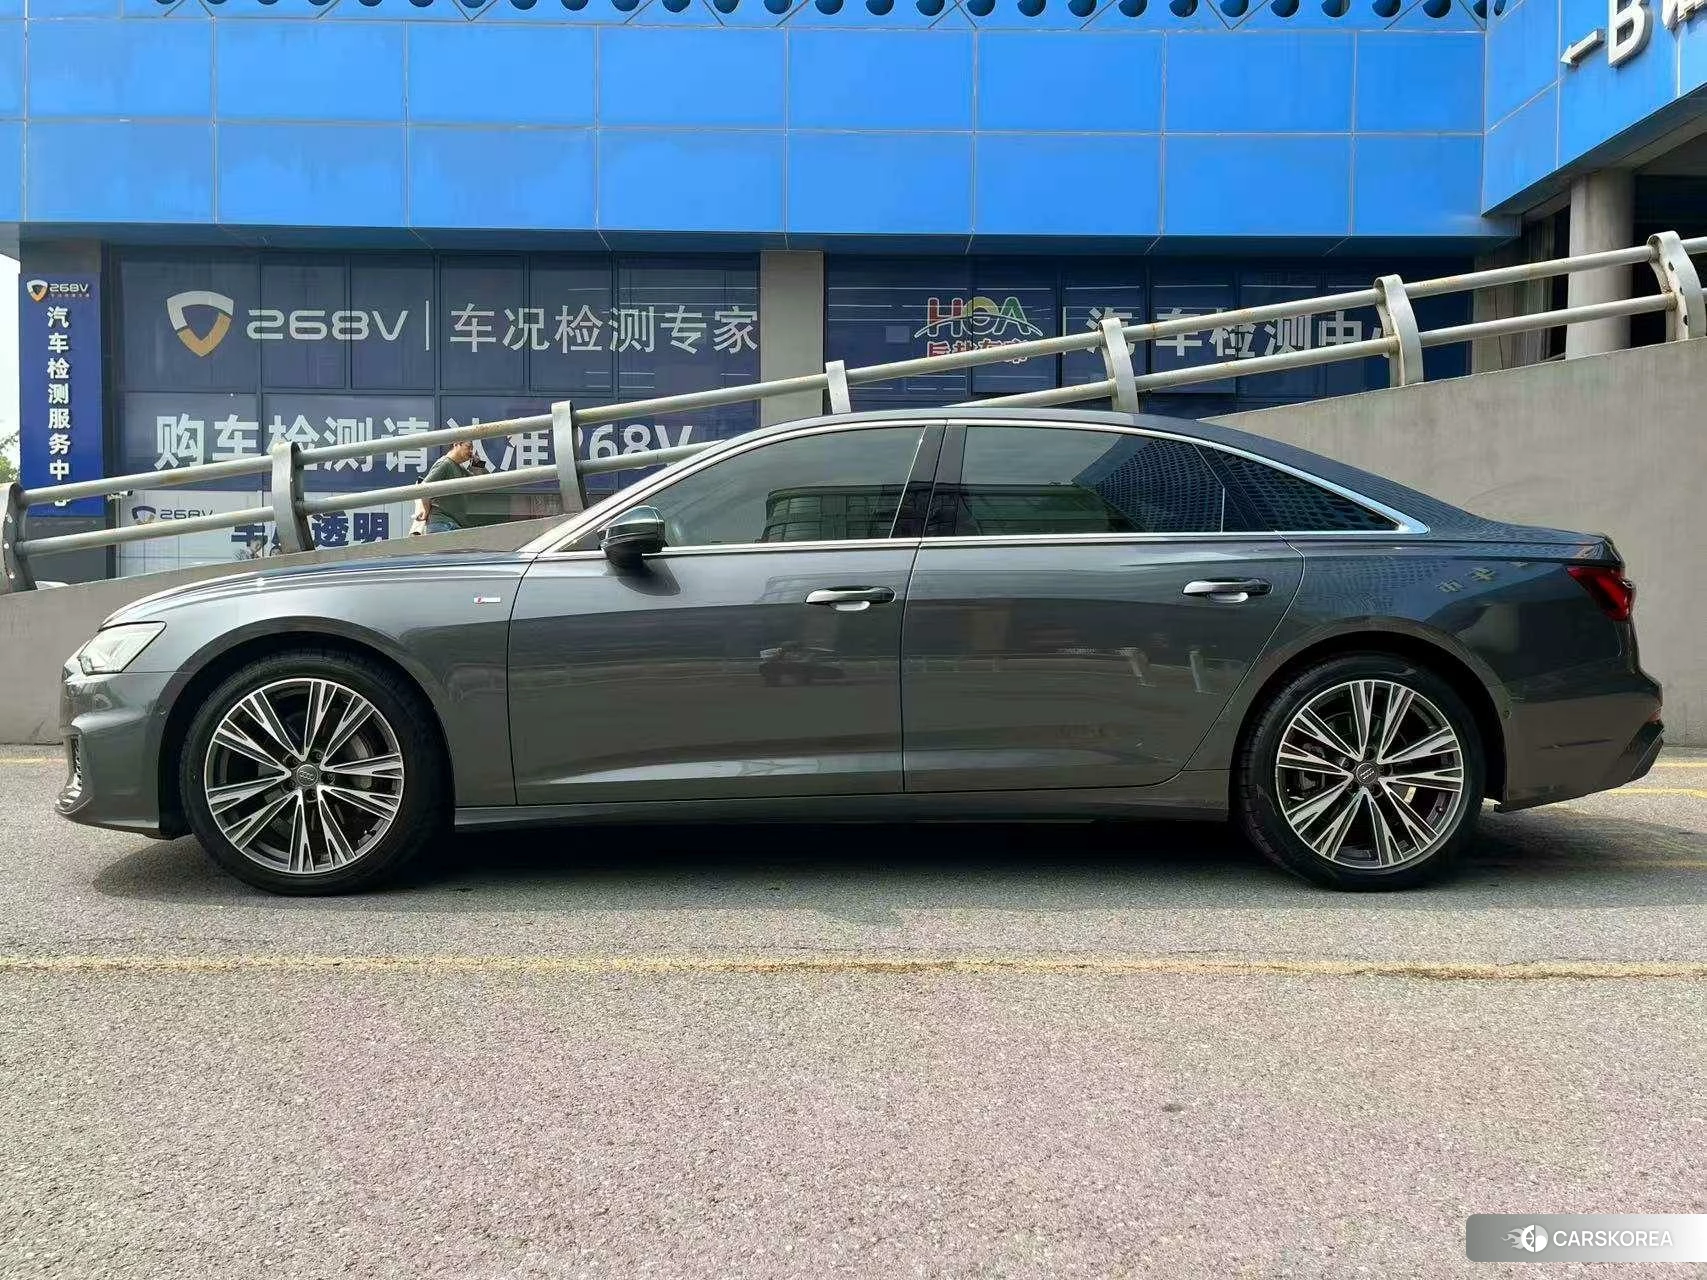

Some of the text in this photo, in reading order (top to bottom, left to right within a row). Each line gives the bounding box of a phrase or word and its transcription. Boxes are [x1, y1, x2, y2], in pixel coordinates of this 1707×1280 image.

[49, 283, 88, 292] 268V
[247, 302, 758, 354] 268V 车况检测专家
[1086, 307, 1390, 358] 车检测中
[154, 412, 692, 474] 购车检测请准68V
[231, 510, 389, 548] 车透明
